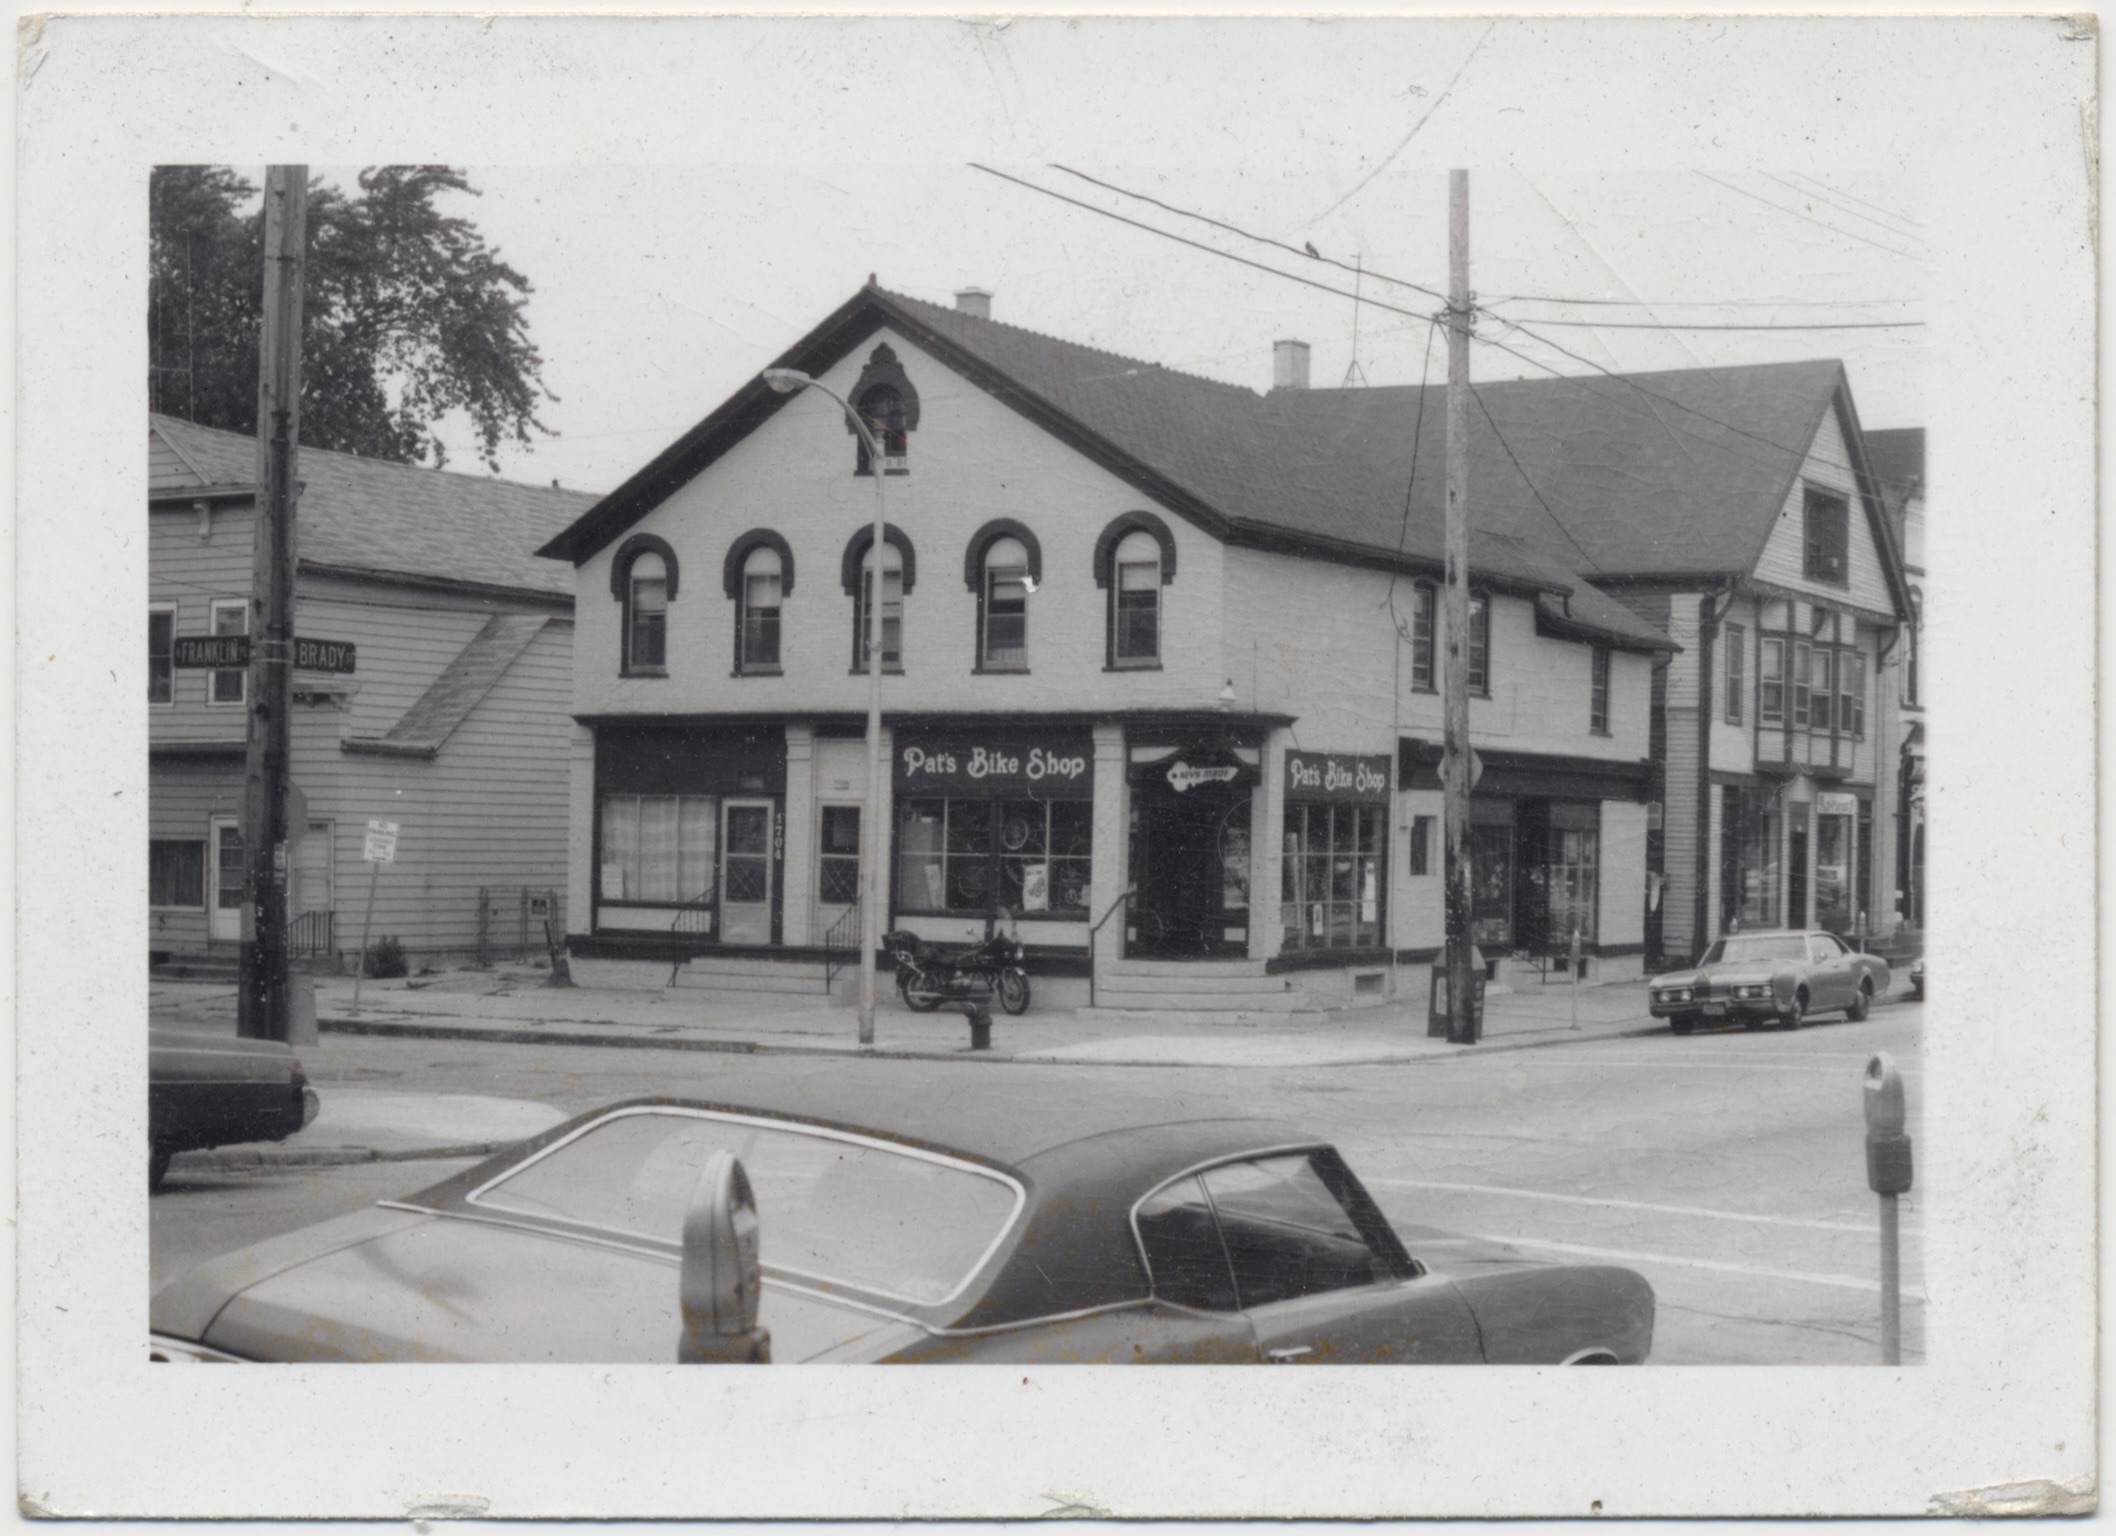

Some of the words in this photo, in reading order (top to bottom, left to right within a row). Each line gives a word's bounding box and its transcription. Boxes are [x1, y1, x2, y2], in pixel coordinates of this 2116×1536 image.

[181, 641, 238, 664] FRANKLIN
[299, 643, 346, 668] BRADY
[903, 746, 957, 777] Pat's
[967, 746, 1020, 779] Bike
[1026, 748, 1085, 780] Shop
[1180, 770, 1201, 780] KEYS
[1203, 769, 1229, 778] MADE
[1290, 758, 1321, 789] Pat's
[1325, 760, 1353, 791] Bike
[1356, 762, 1386, 793] Shop
[378, 822, 388, 830] NO
[774, 812, 783, 860] 1704
